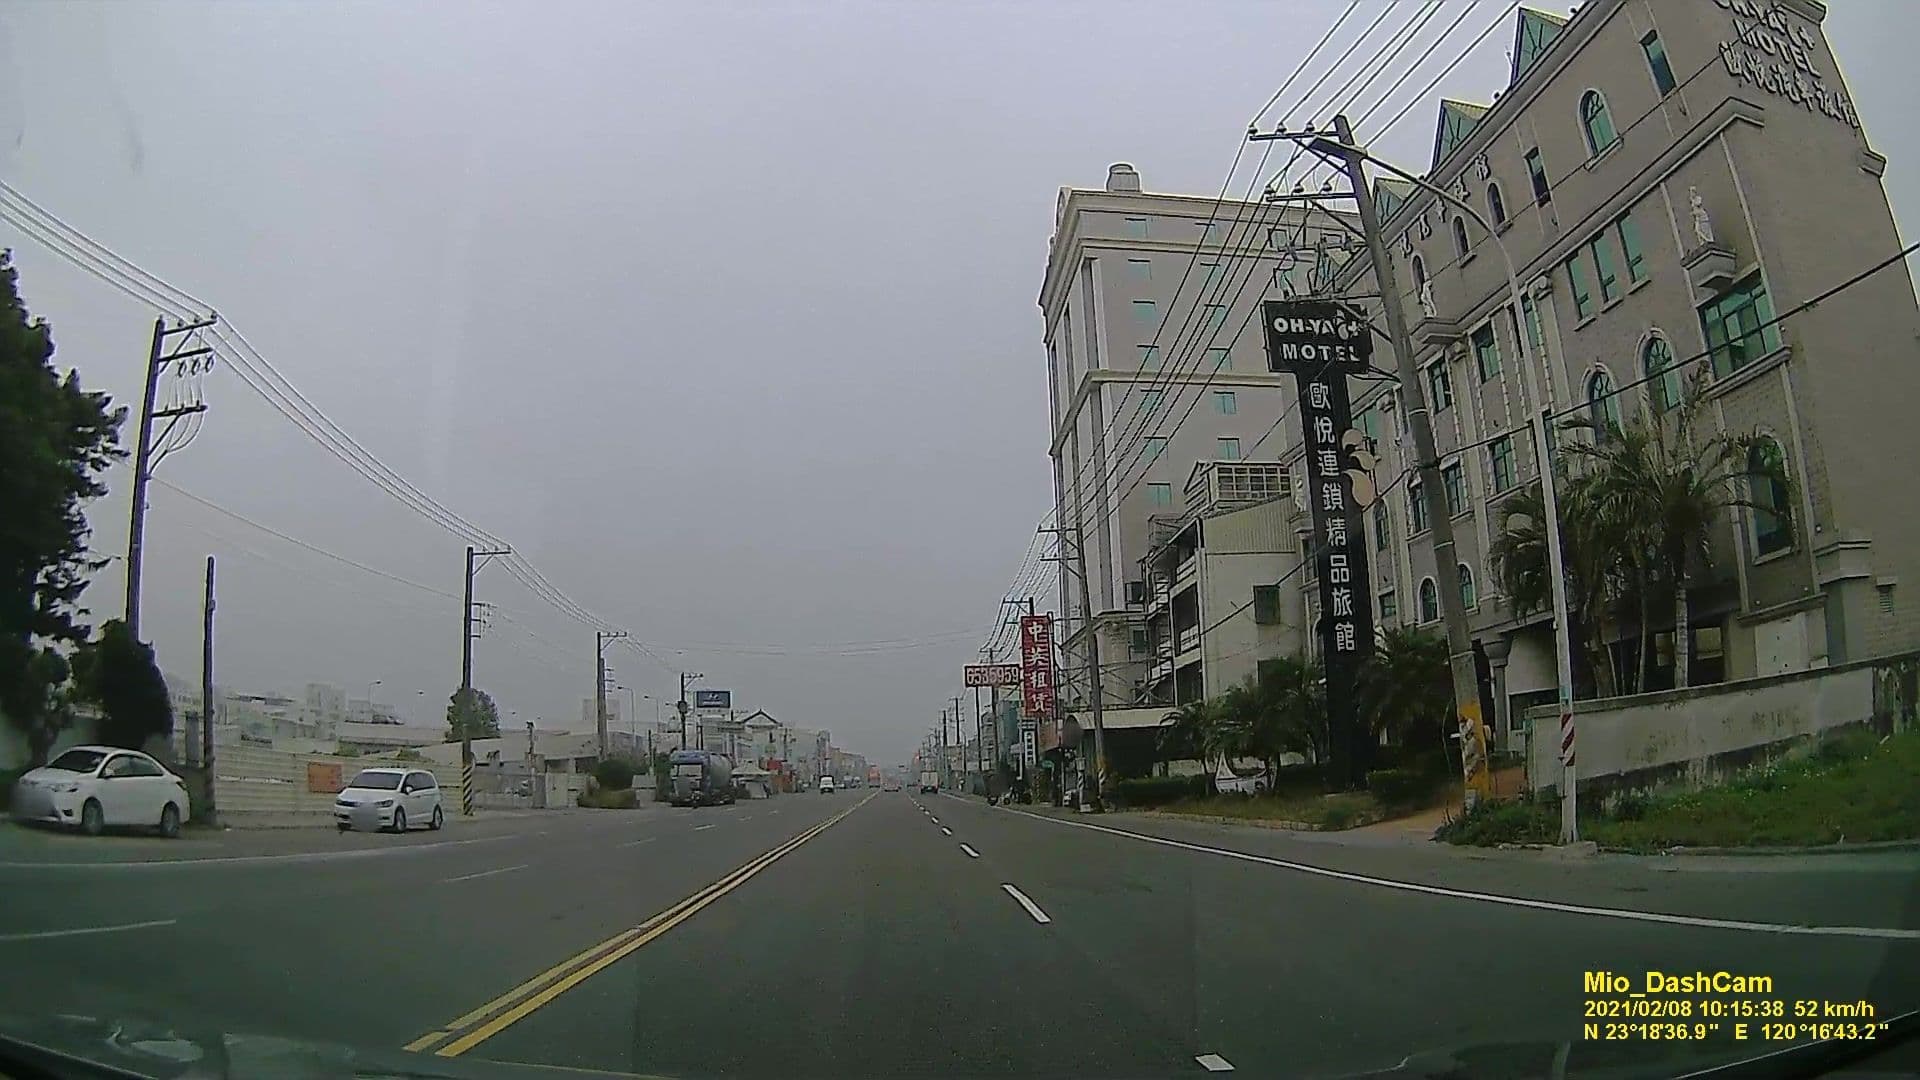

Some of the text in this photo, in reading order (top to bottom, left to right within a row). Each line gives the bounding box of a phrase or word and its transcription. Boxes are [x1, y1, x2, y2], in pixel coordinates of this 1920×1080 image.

[1733, 19, 1822, 78] MOTEL
[1282, 343, 1361, 361] MOTEL
[1309, 382, 1356, 652] 歐悅連鎖精品旅館
[966, 667, 1020, 685] 6535959
